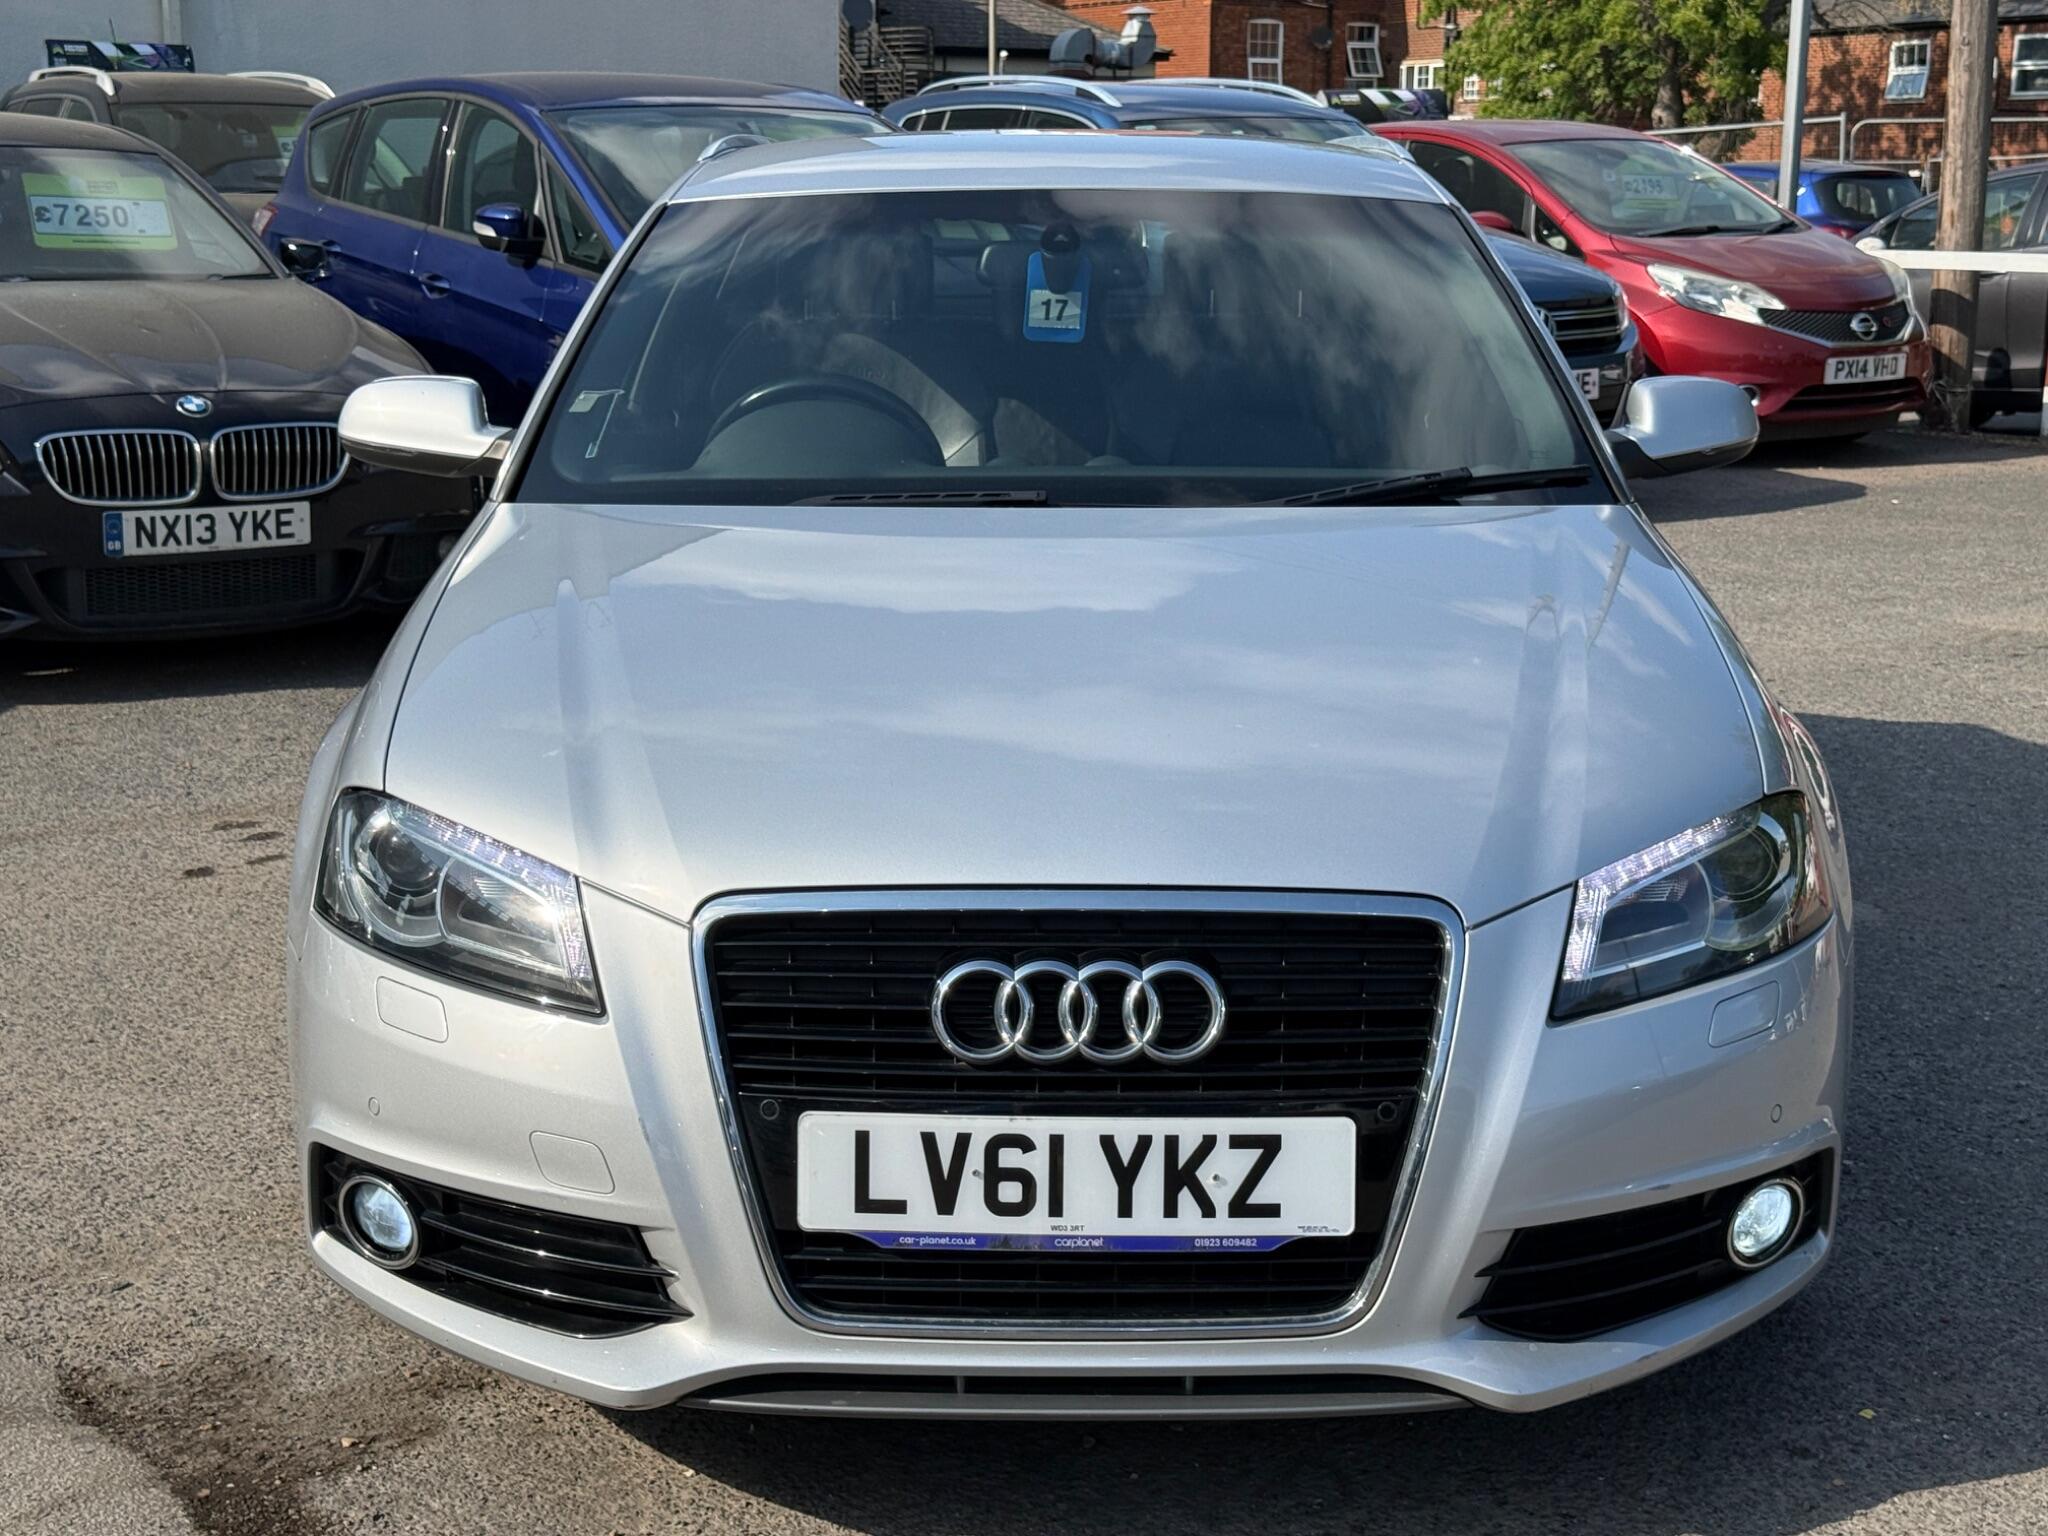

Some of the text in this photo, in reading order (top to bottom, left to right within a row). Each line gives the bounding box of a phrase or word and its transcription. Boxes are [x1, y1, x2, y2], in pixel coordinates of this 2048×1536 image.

[34, 203, 129, 228] £7250
[1041, 298, 1069, 322] 17
[1834, 357, 1899, 380] PX14 VHD
[135, 508, 295, 548] NX13 YKE
[107, 541, 122, 551] GB
[854, 1130, 1282, 1219] LV61 YKZ
[899, 1235, 977, 1246] car-planet.co.uk
[1054, 1237, 1104, 1248] carplanet
[1194, 1238, 1257, 1247] 01923 609482
